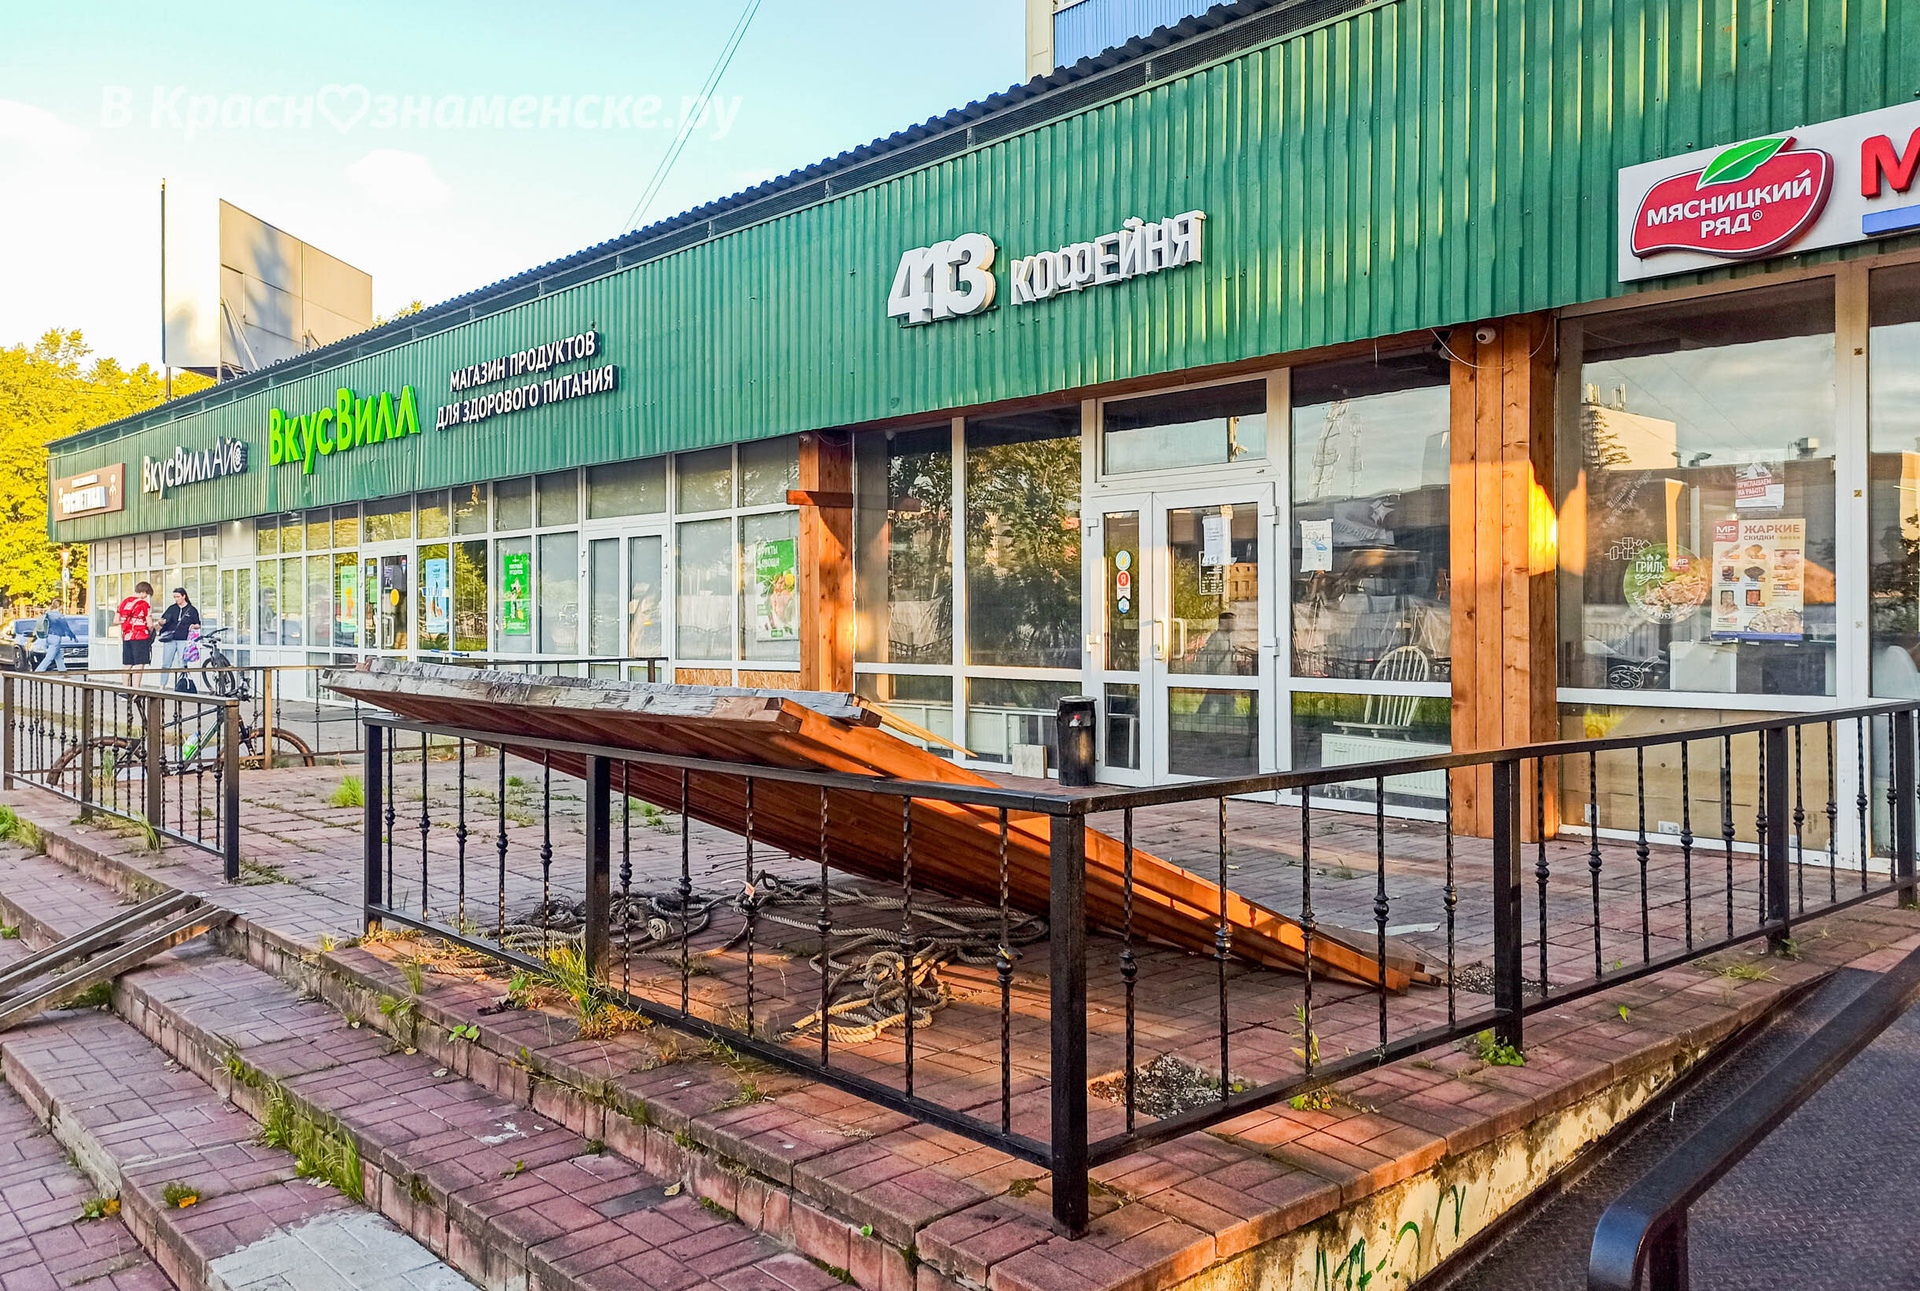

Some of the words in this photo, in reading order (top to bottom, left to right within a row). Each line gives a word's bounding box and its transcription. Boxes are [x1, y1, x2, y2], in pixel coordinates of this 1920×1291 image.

[1647, 169, 1811, 226] МЯСНИЦКИЙ
[888, 232, 996, 323] 413
[1010, 210, 1204, 305] КОФЕЙНЯ
[450, 356, 505, 392] МАГАЗИН
[510, 330, 596, 377] ПРОДУКТОВ
[436, 402, 460, 431] ДЛЯ
[462, 383, 539, 424] ЗДОРОВОГО
[543, 364, 614, 404] ПИТАНИЯ
[269, 385, 421, 475] ВкусВилл
[1744, 524, 1800, 534] ЖАРКИЕ
[1635, 561, 1666, 573] ГРИЛЬ
